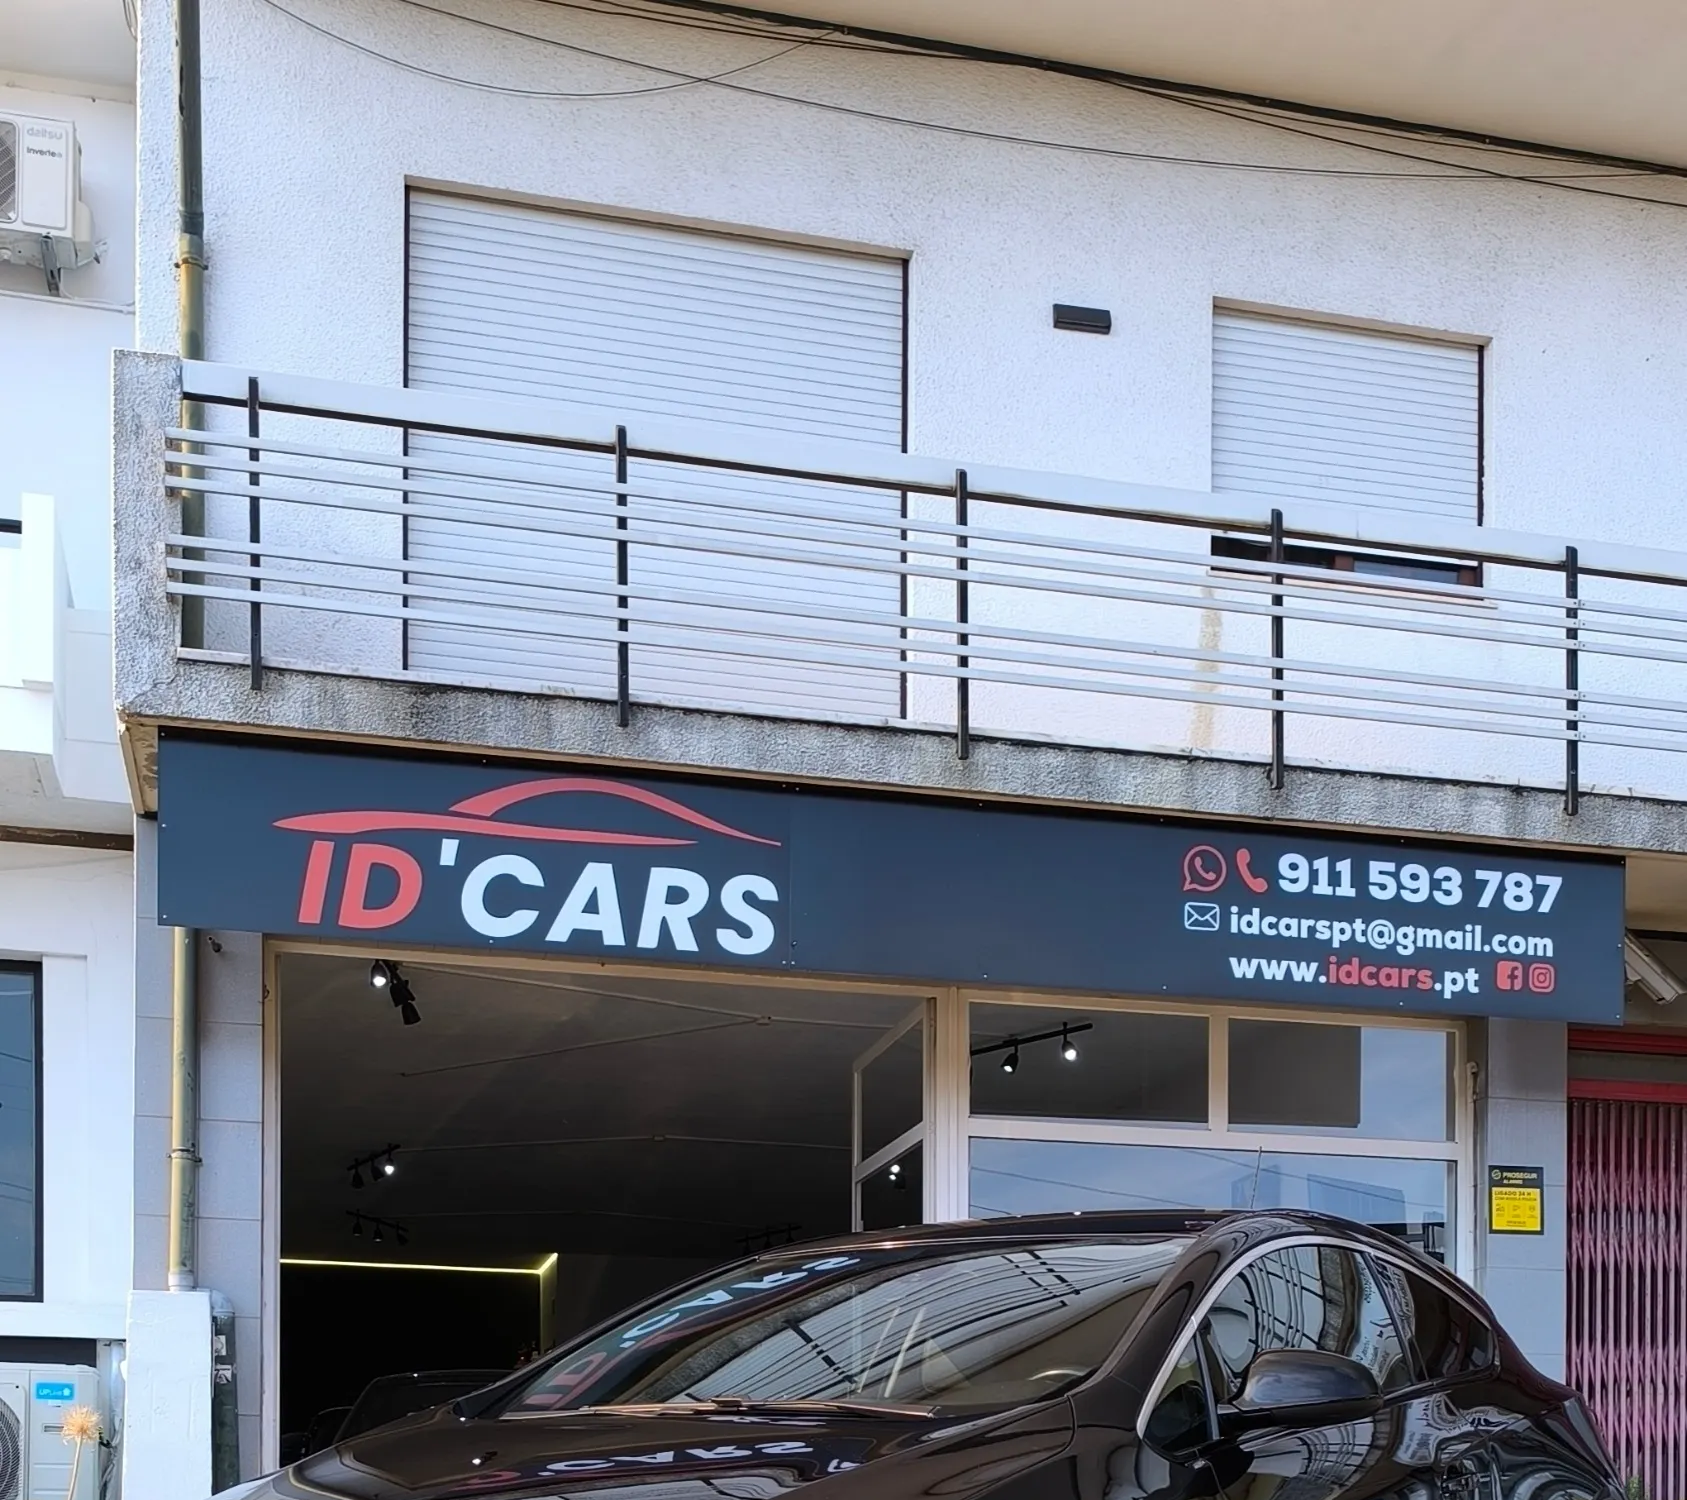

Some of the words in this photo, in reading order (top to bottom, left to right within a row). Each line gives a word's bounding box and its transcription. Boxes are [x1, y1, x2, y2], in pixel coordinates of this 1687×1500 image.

[298, 838, 779, 956] ID'CARS
[1278, 852, 1356, 897] 911
[1368, 861, 1463, 906] 593
[1474, 869, 1563, 913] 787
[1229, 905, 1554, 957] idcarspt@gmail.com
[1229, 956, 1480, 999] www.idcars.pt
